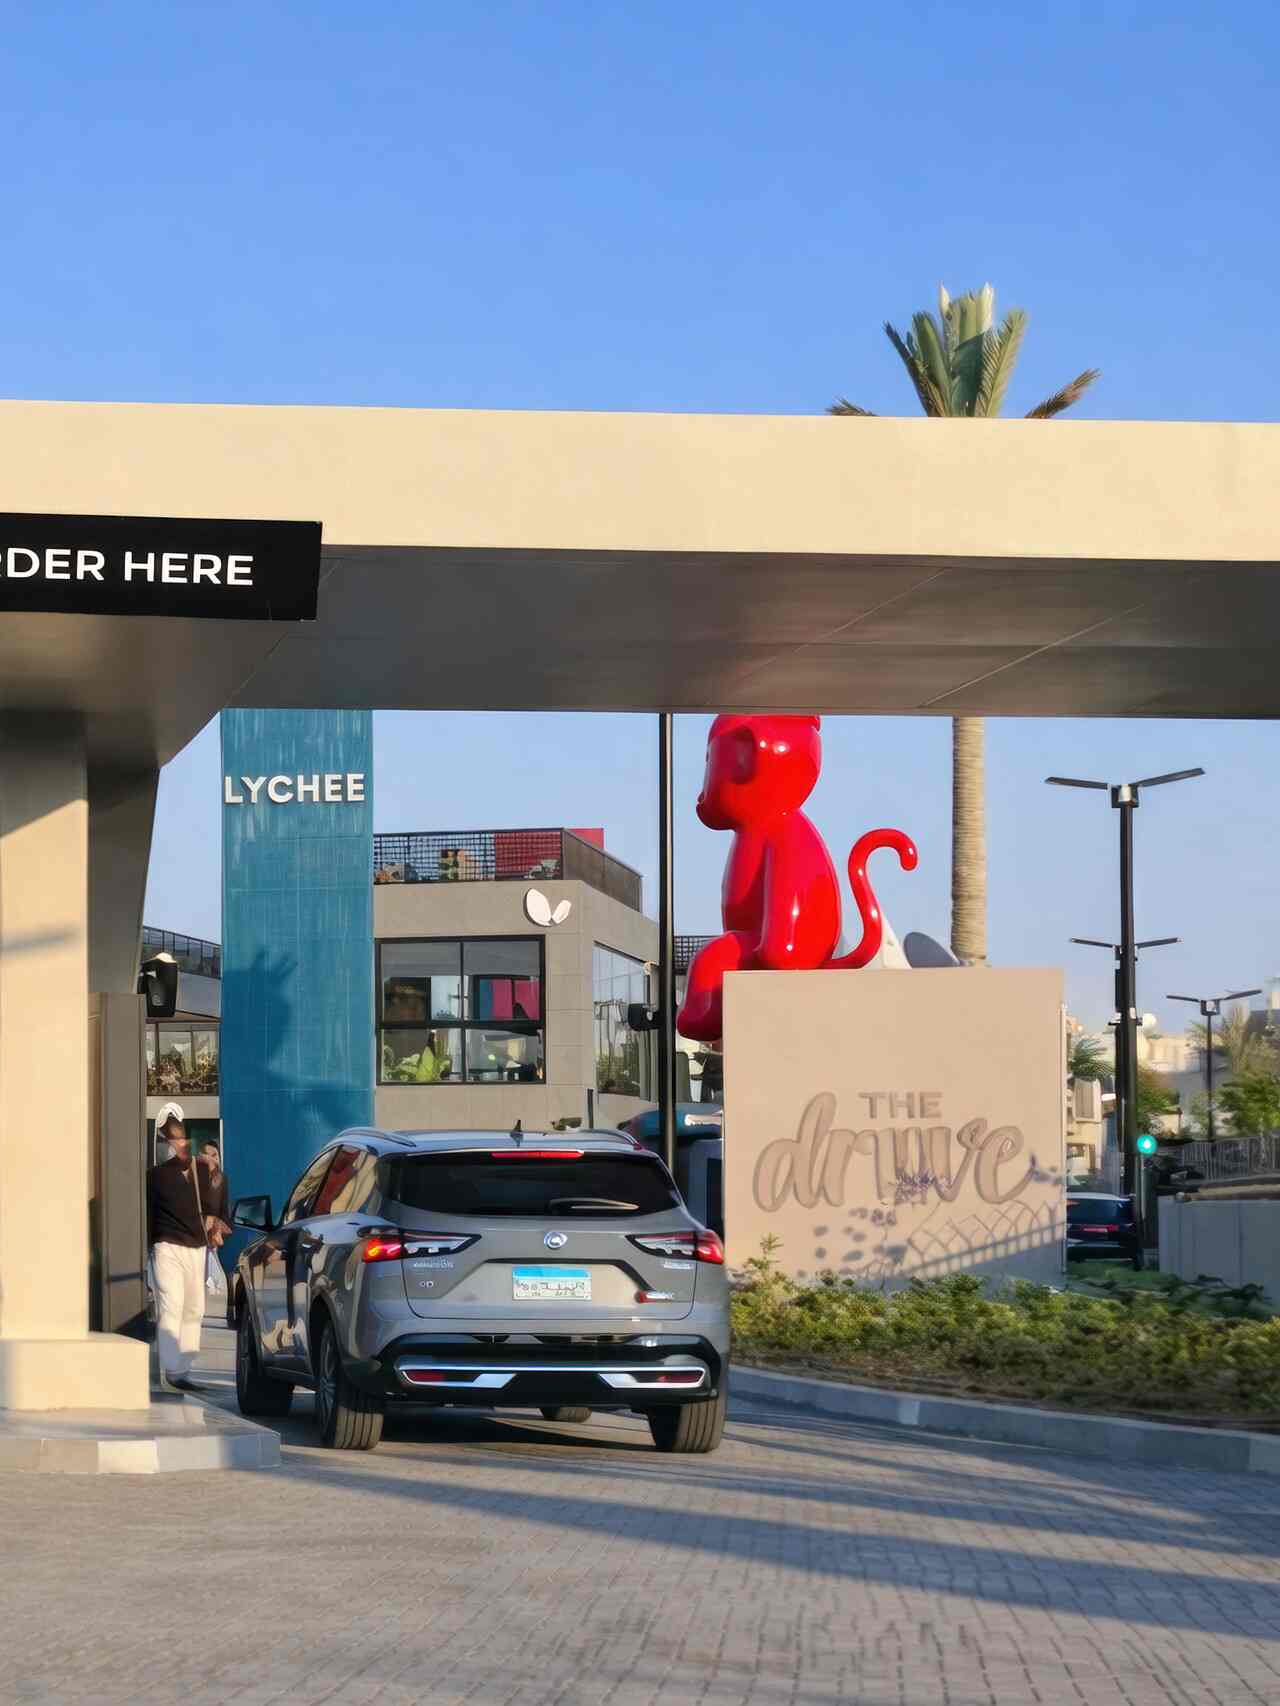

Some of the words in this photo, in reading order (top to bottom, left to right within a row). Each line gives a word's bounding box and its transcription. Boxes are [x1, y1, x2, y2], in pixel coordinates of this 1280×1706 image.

[124, 551, 254, 586] HERE
[224, 773, 366, 804] LYCHEE
[858, 1091, 944, 1119] THE
